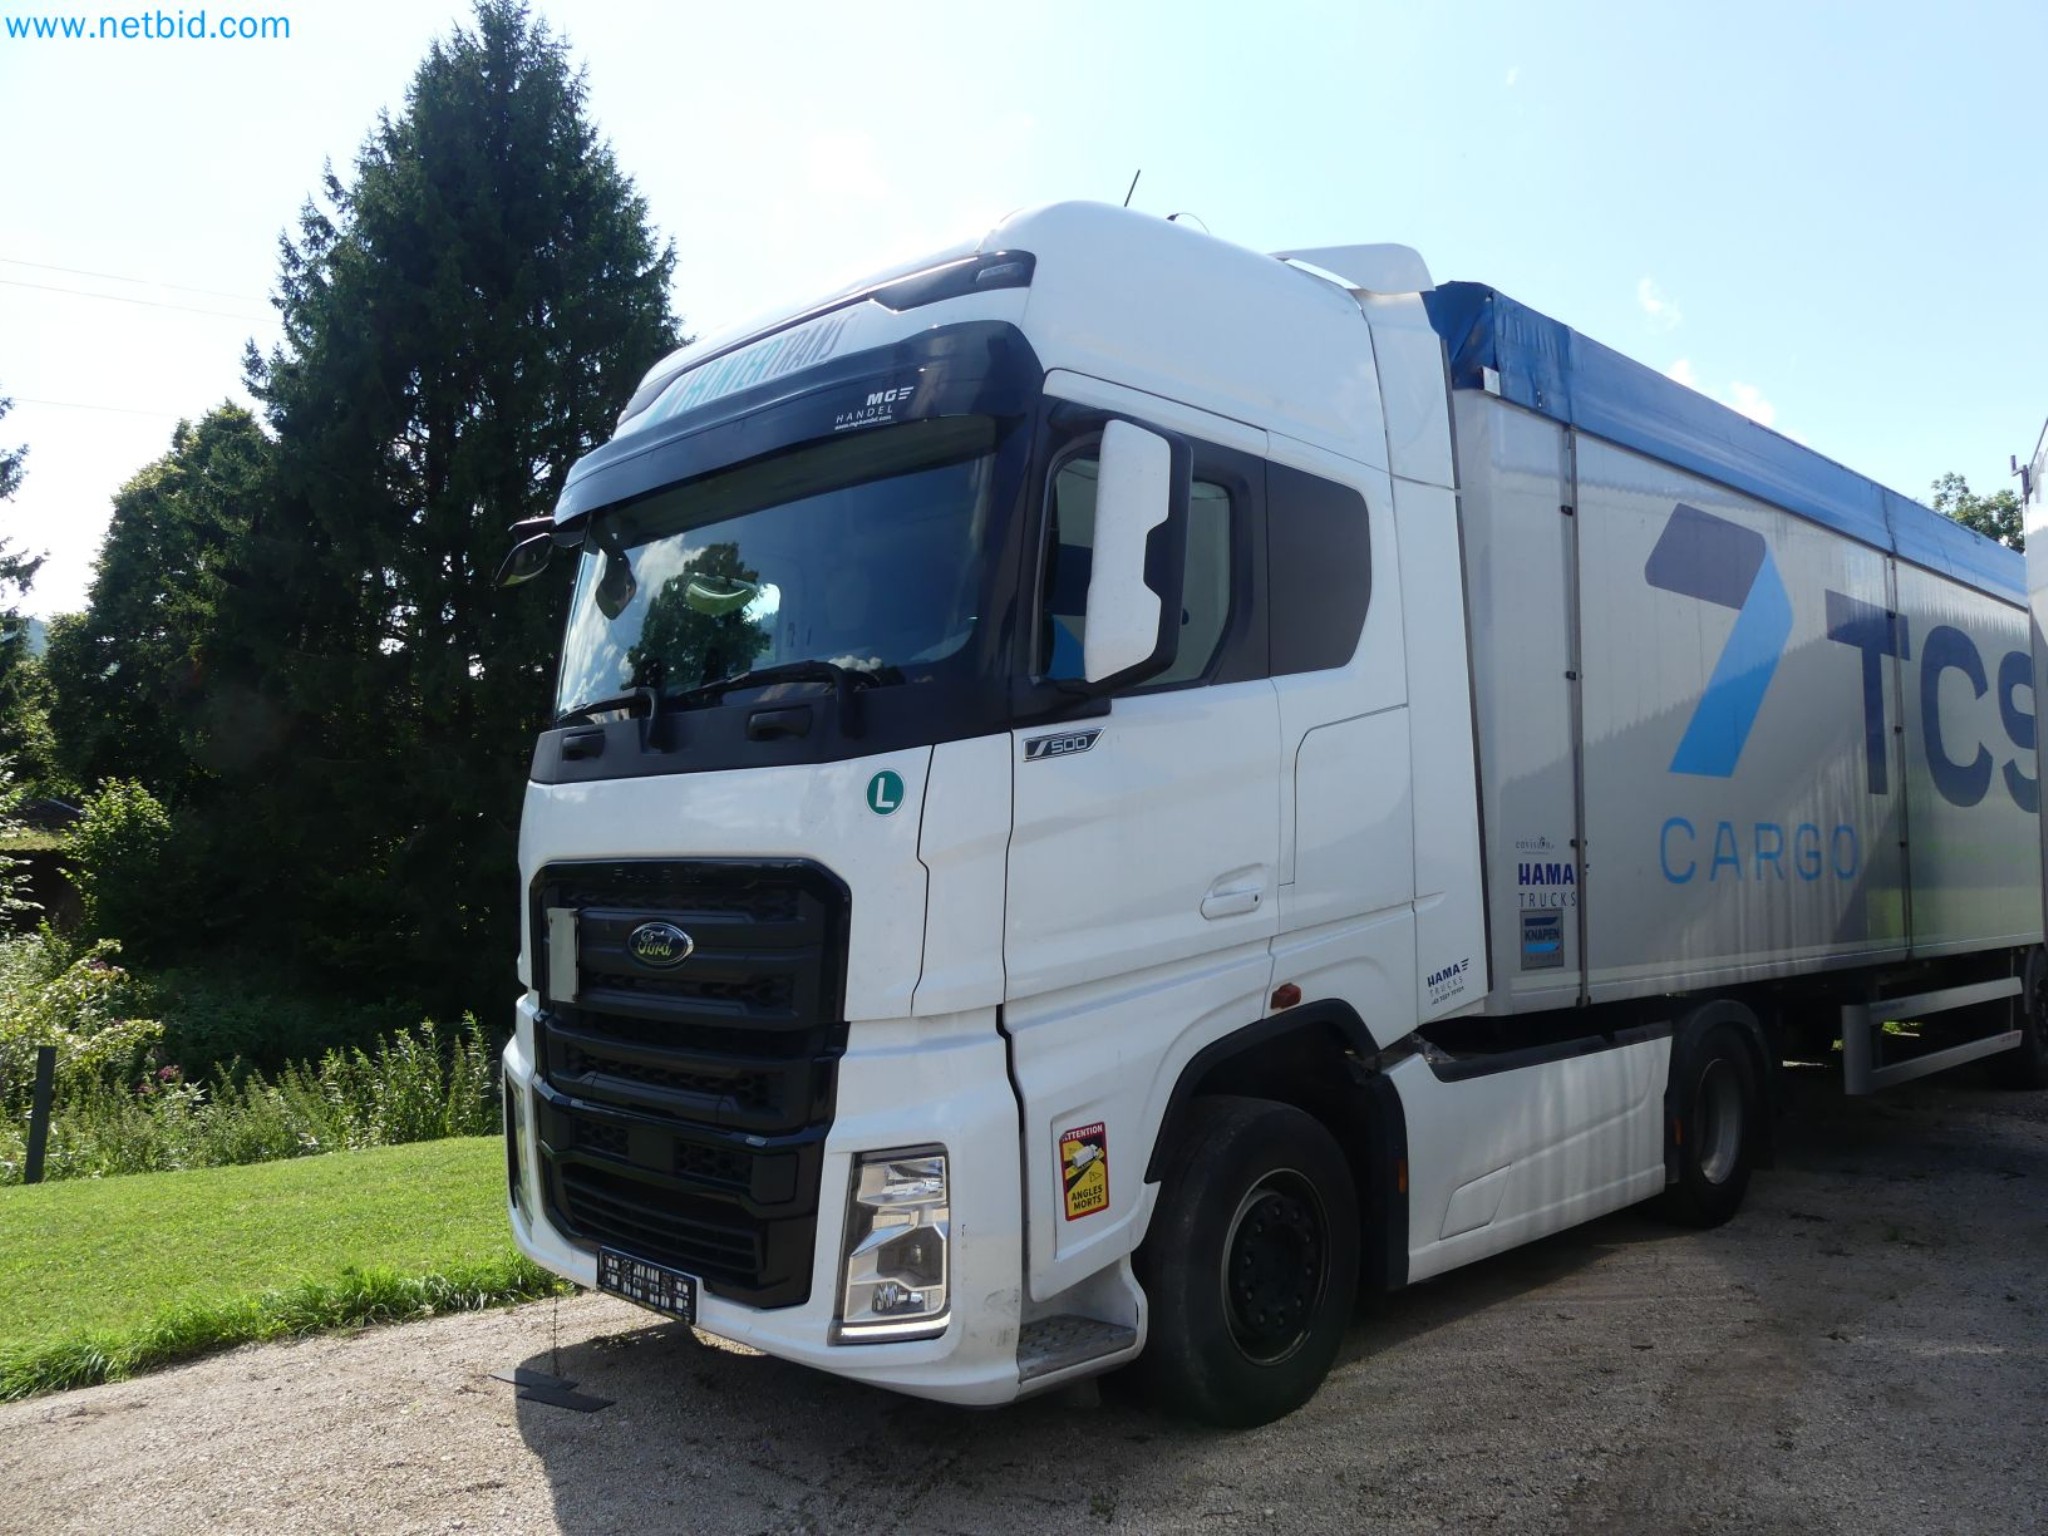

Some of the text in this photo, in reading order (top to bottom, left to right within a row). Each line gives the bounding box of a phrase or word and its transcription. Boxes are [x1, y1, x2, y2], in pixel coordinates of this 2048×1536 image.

[836, 405, 893, 423] HANDEL
[1051, 736, 1088, 754] 500
[876, 777, 895, 808] L
[1659, 816, 1860, 884] CARGO
[1517, 863, 1575, 886] HAMA
[1518, 891, 1577, 907] TRUCKS
[638, 929, 673, 957] Ford
[1525, 928, 1560, 942] KNAPEN
[1427, 963, 1461, 988] HAMA
[1071, 1184, 1103, 1201] ANGLES
[1073, 1195, 1103, 1211] MORTS
